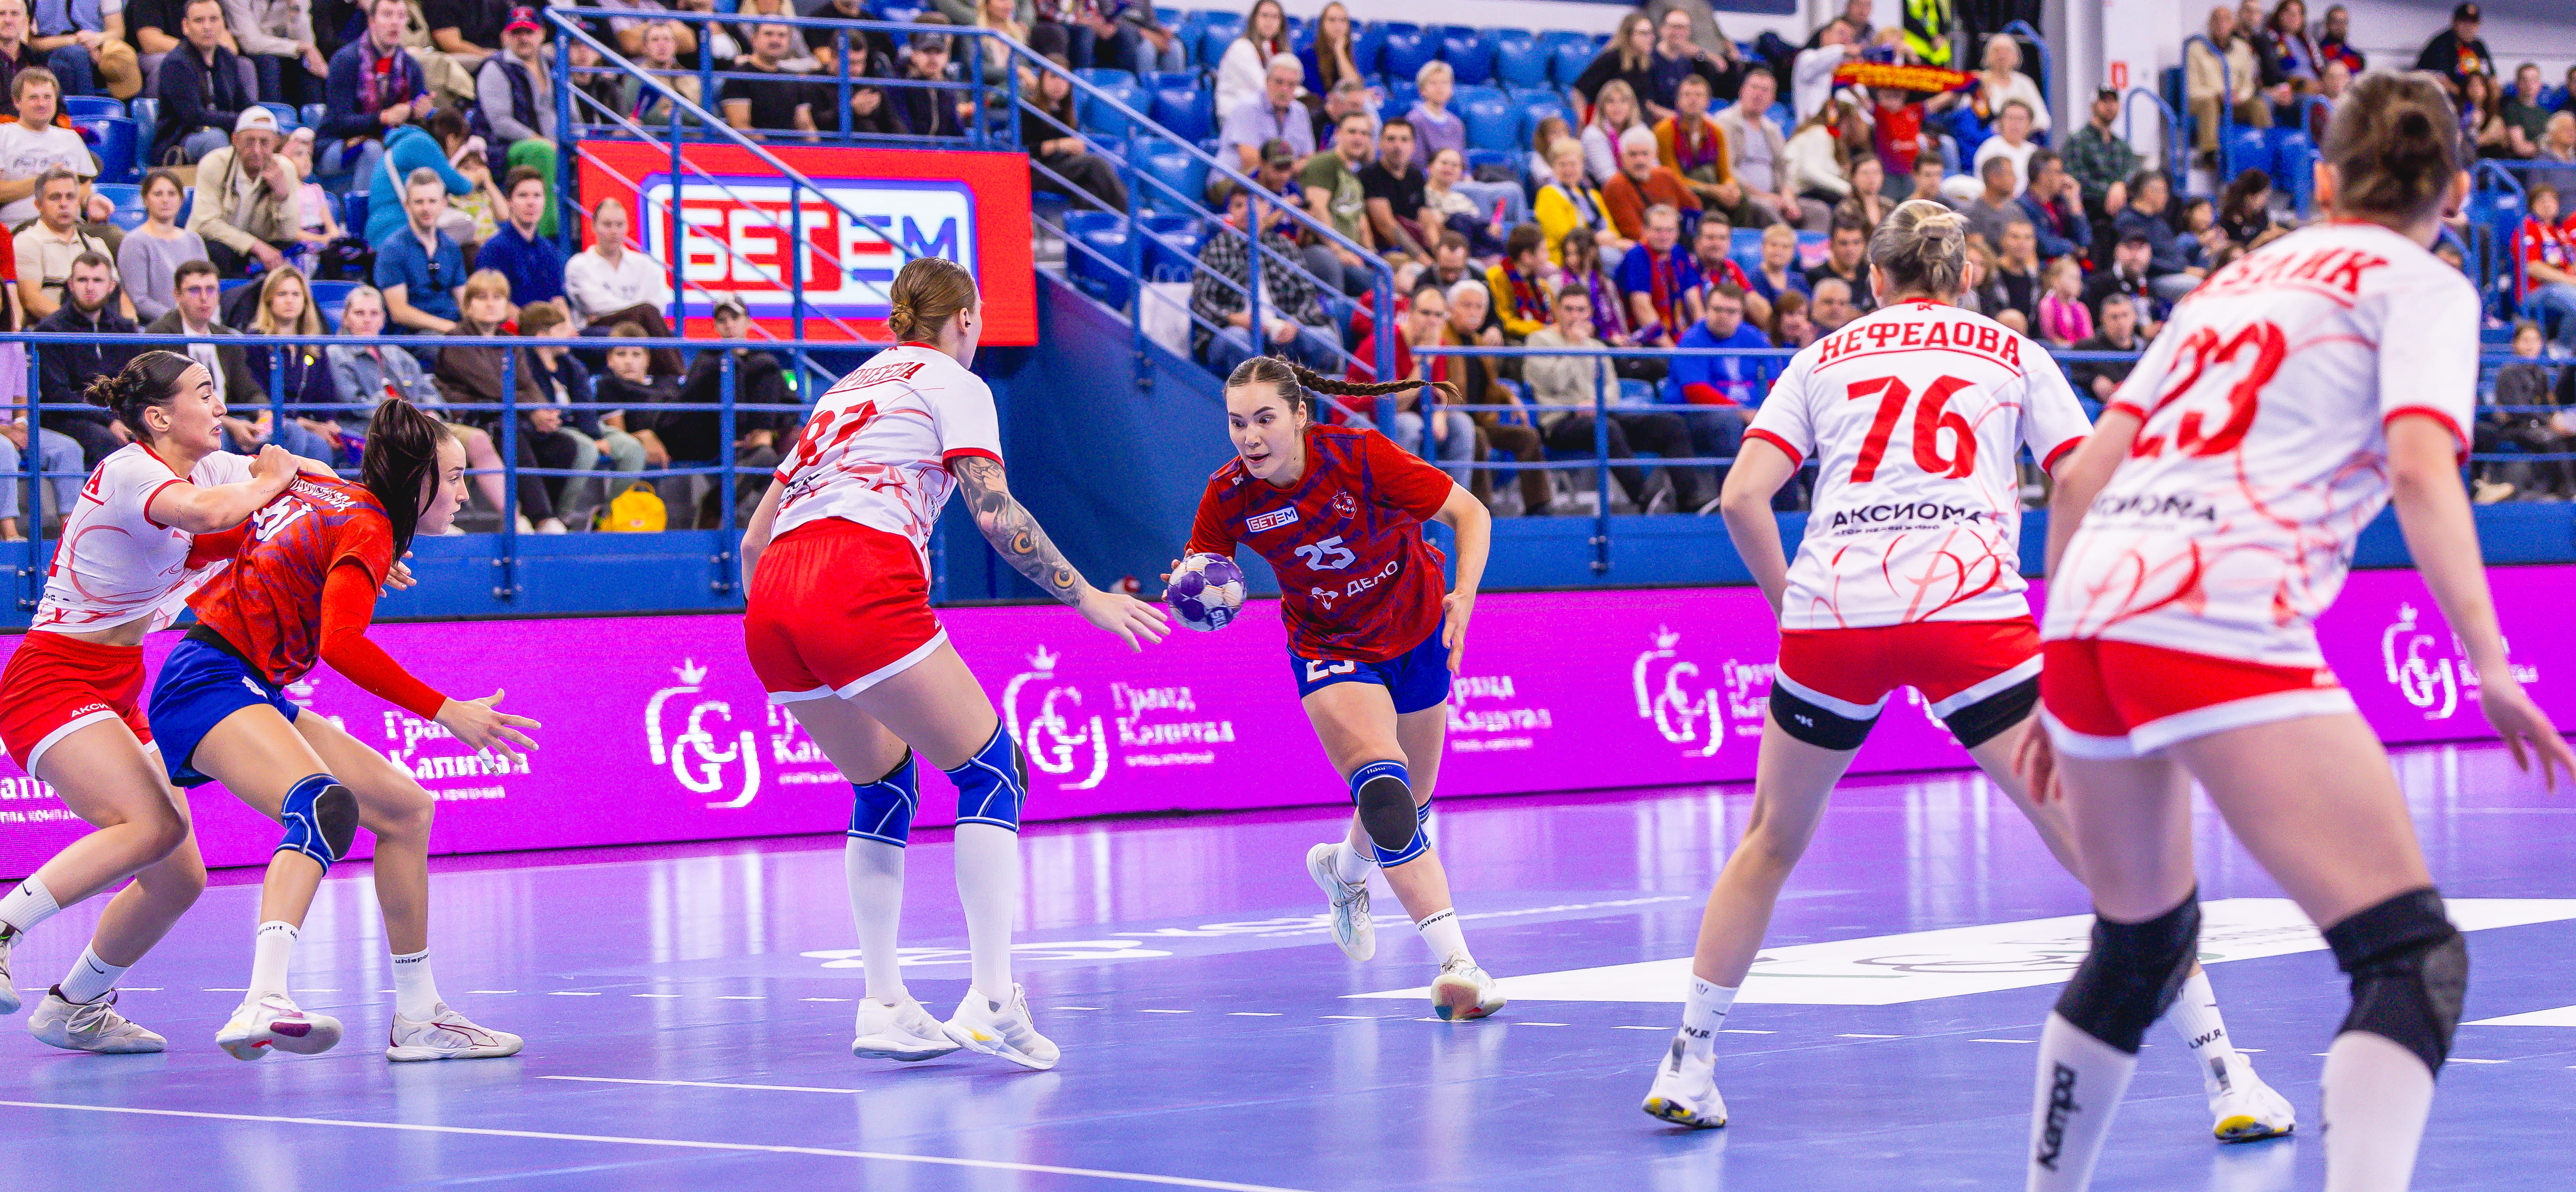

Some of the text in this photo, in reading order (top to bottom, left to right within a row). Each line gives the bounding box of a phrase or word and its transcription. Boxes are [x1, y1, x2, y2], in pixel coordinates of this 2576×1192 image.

[1818, 321, 2020, 367] НЕФЕДОВА
[831, 362, 926, 390] ОРНЕЕВА
[2132, 318, 2285, 458] 23
[793, 400, 878, 467] 87
[1847, 375, 1977, 484] 76
[1832, 503, 1981, 529] АКСИОМА
[1294, 536, 1356, 571] 25
[1347, 561, 1398, 597] ДЕЛО
[2037, 1060, 2081, 1173] Kempa
